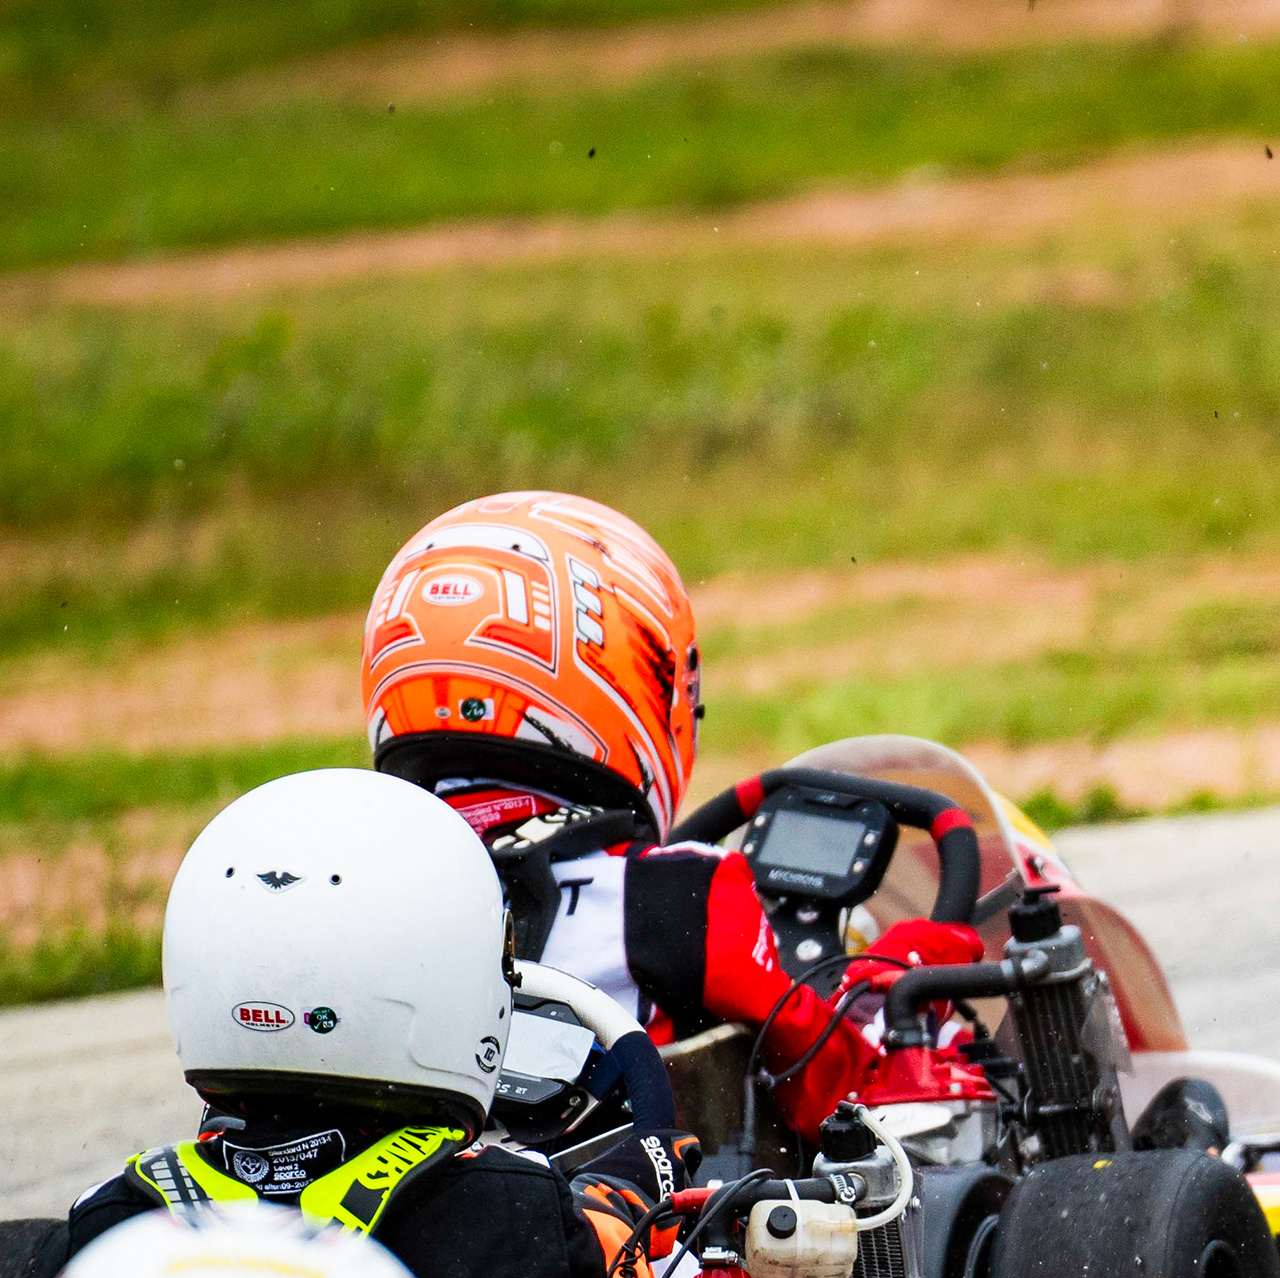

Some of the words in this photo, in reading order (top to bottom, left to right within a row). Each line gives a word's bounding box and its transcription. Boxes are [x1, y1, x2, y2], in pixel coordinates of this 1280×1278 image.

[429, 583, 472, 595] BELL
[240, 1007, 286, 1024] BELL
[272, 1148, 318, 1163] 2013/047
[273, 1164, 293, 1172] Level
[273, 1169, 307, 1181] sparco
